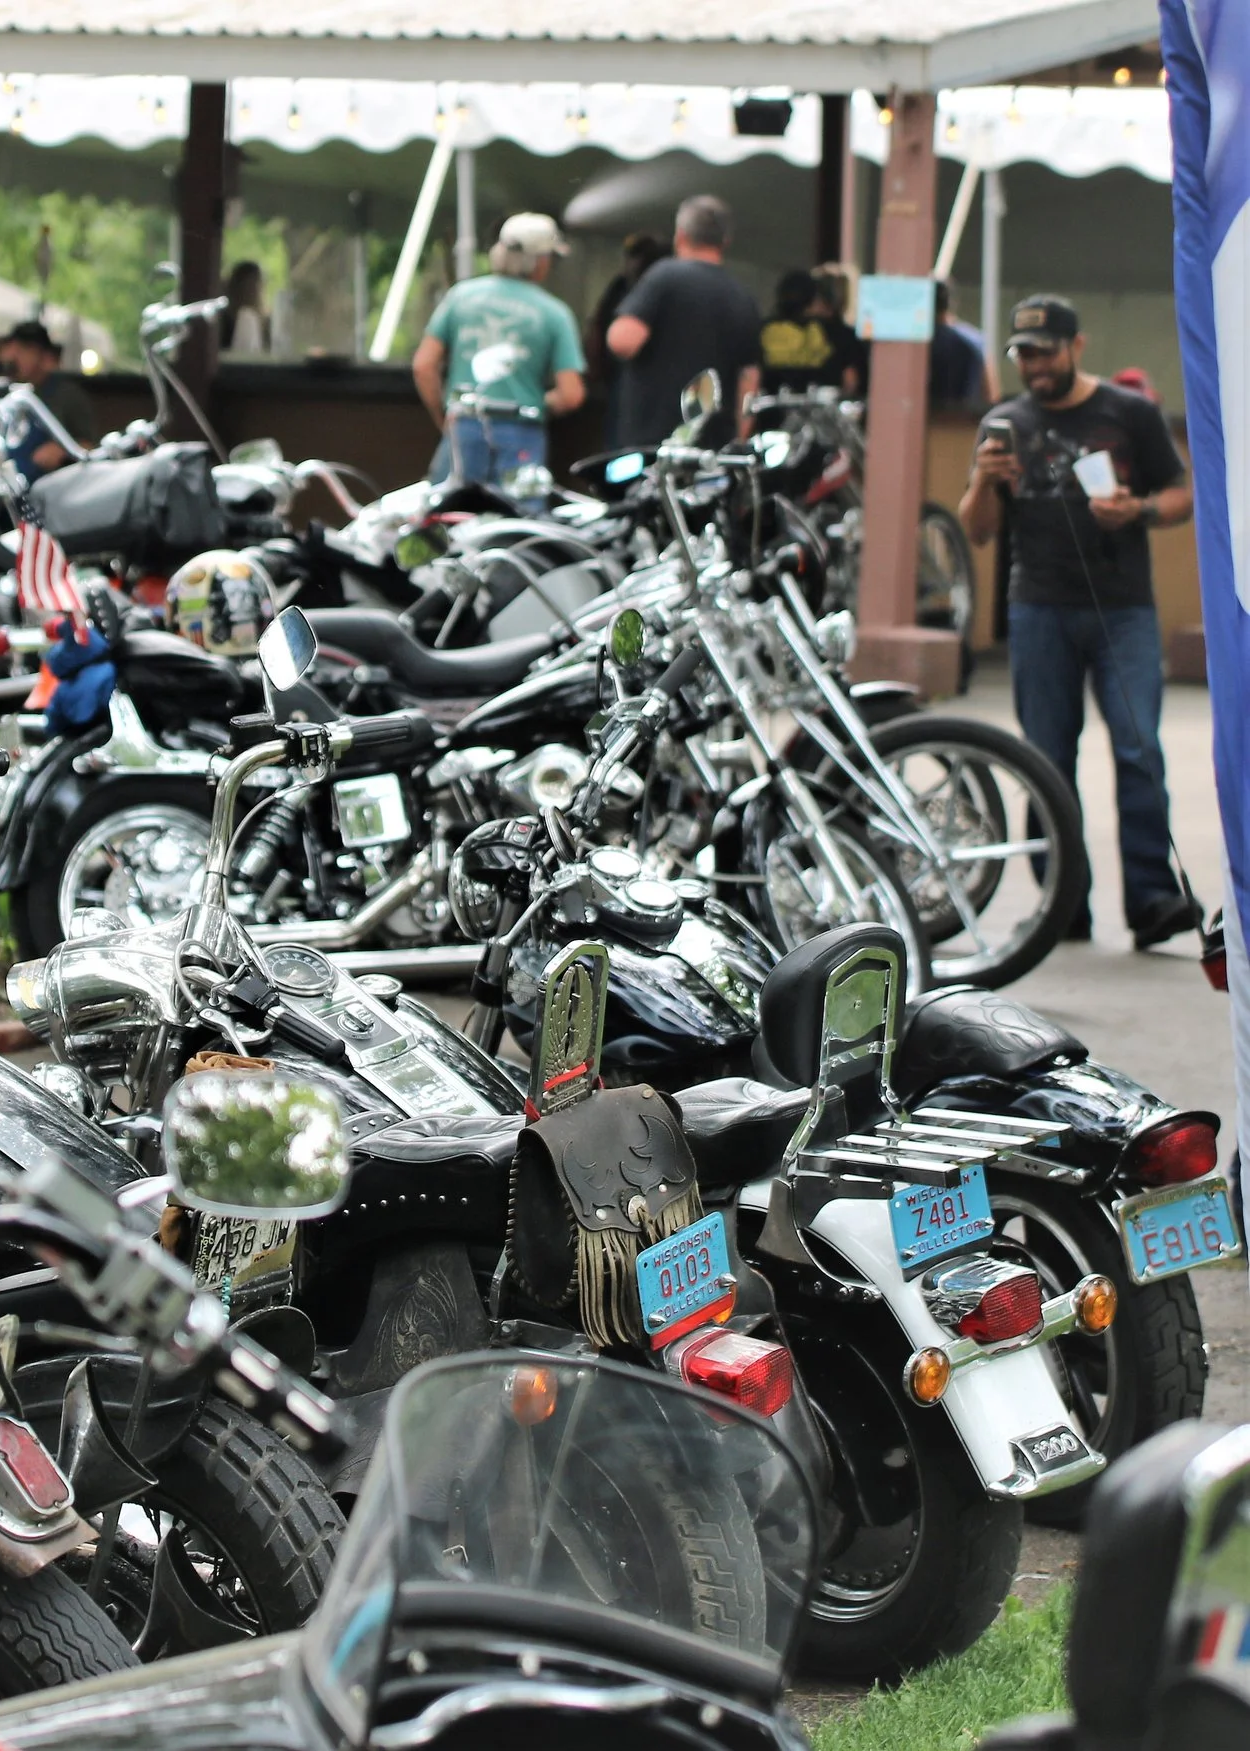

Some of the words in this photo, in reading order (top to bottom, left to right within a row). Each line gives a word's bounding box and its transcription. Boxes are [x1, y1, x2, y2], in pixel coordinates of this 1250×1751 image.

[911, 1191, 969, 1237] Z481
[653, 1227, 712, 1268] WISCONSIN
[910, 1219, 987, 1257] COLLECTOR
[1141, 1215, 1222, 1268] E816
[657, 1277, 722, 1319] COLLECTOR
[1032, 1432, 1078, 1462] 1200
